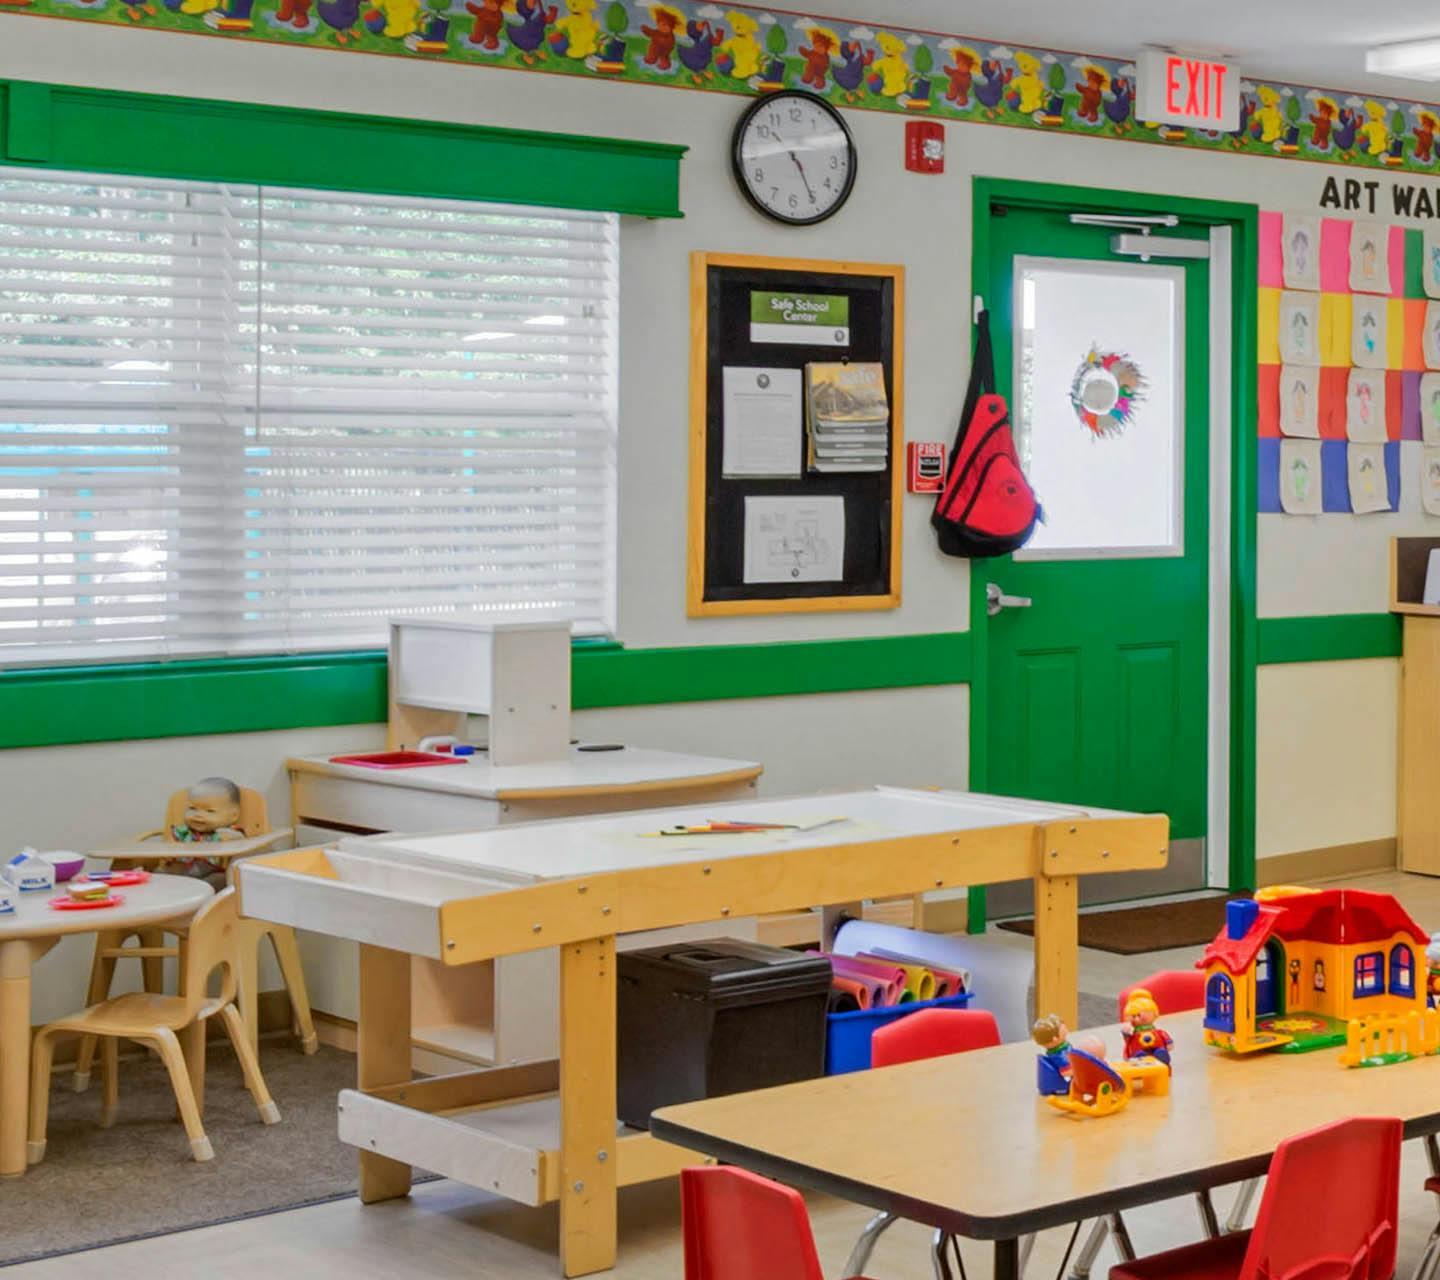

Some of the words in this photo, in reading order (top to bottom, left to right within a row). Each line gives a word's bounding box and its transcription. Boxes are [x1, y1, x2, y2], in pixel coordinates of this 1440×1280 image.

[1166, 56, 1228, 120] EXIT
[770, 113, 781, 128] 11
[788, 107, 802, 123] 12
[756, 124, 769, 138] 10
[829, 155, 838, 170] 3
[754, 168, 764, 183] 8
[822, 176, 832, 189] 4
[770, 186, 780, 201] 7
[1319, 176, 1380, 215] ART
[788, 194, 798, 209] 6
[770, 297, 794, 311] Safe
[795, 299, 830, 313] School
[783, 309, 818, 322] Center
[918, 442, 942, 457] FIRE
[21, 877, 47, 885] MILK
